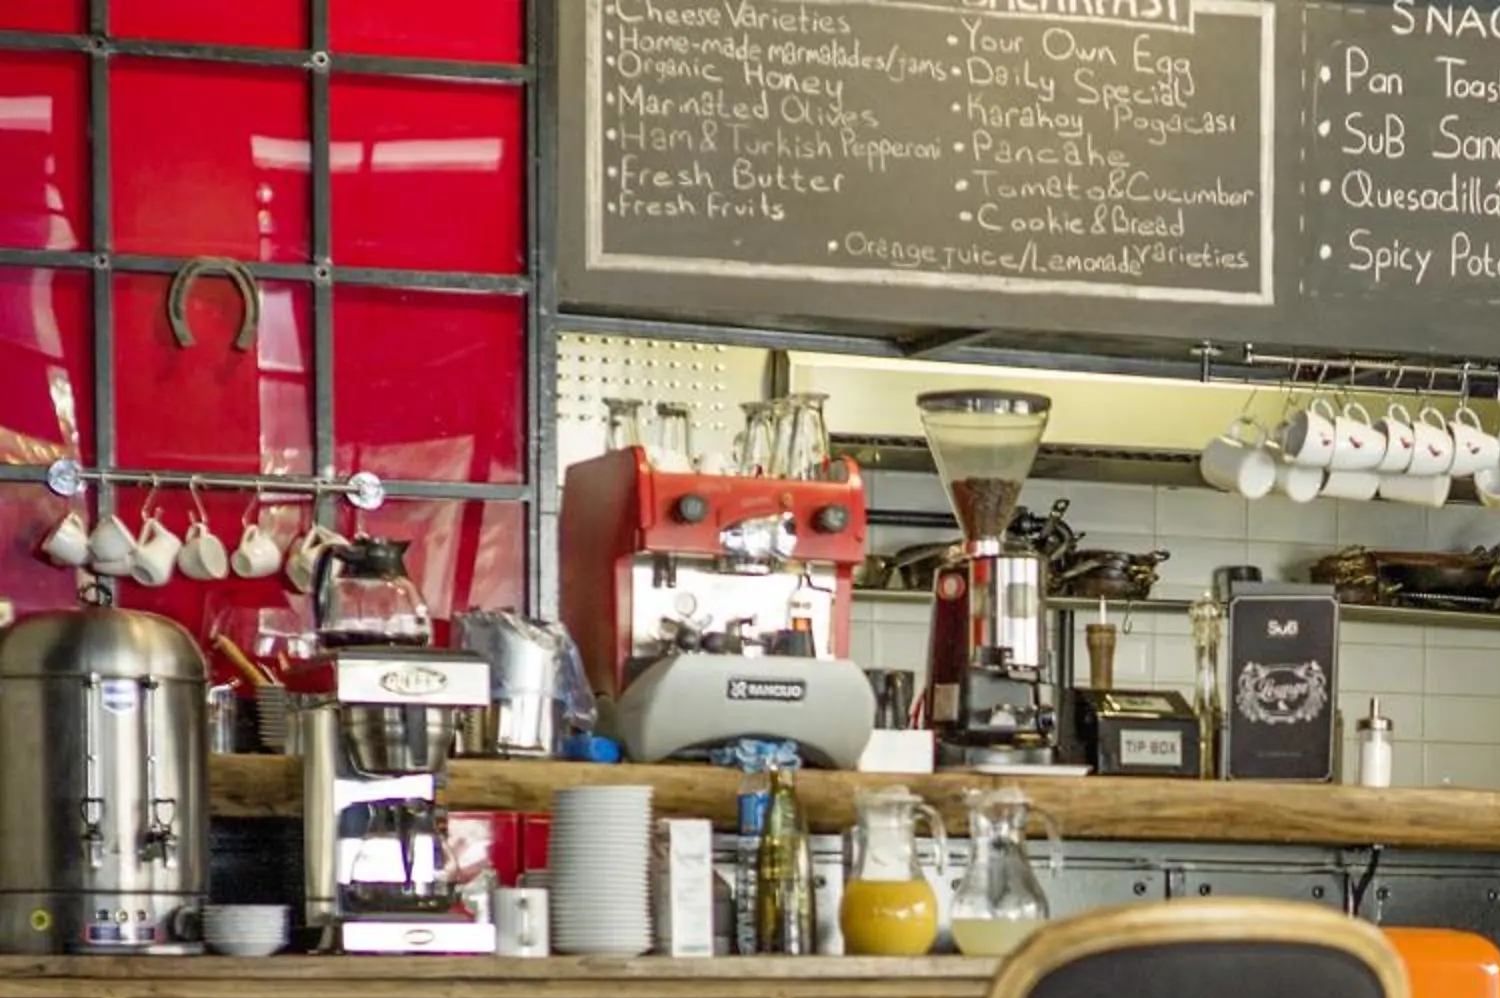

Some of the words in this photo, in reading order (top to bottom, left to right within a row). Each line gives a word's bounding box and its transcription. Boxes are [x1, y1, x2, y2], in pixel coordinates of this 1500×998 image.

[616, 0, 721, 27] Cheese
[724, 0, 850, 33] Varieties
[617, 49, 723, 83] Organic
[744, 62, 843, 97] Honey
[961, 17, 1024, 52] Your
[1043, 27, 1117, 66] Own
[1133, 34, 1195, 96] Egg
[1345, 45, 1403, 95] Pan
[618, 84, 769, 119] Marinated
[781, 95, 879, 128] Olives
[621, 121, 693, 150] Ham
[724, 123, 832, 158] Turkish
[972, 130, 1130, 167] Pancake
[621, 154, 713, 192] Fresh
[733, 157, 845, 192] Butter
[618, 190, 695, 217] Fresh
[707, 191, 785, 220] Fruits
[845, 231, 936, 267] Orange
[1349, 228, 1432, 284] Spicy
